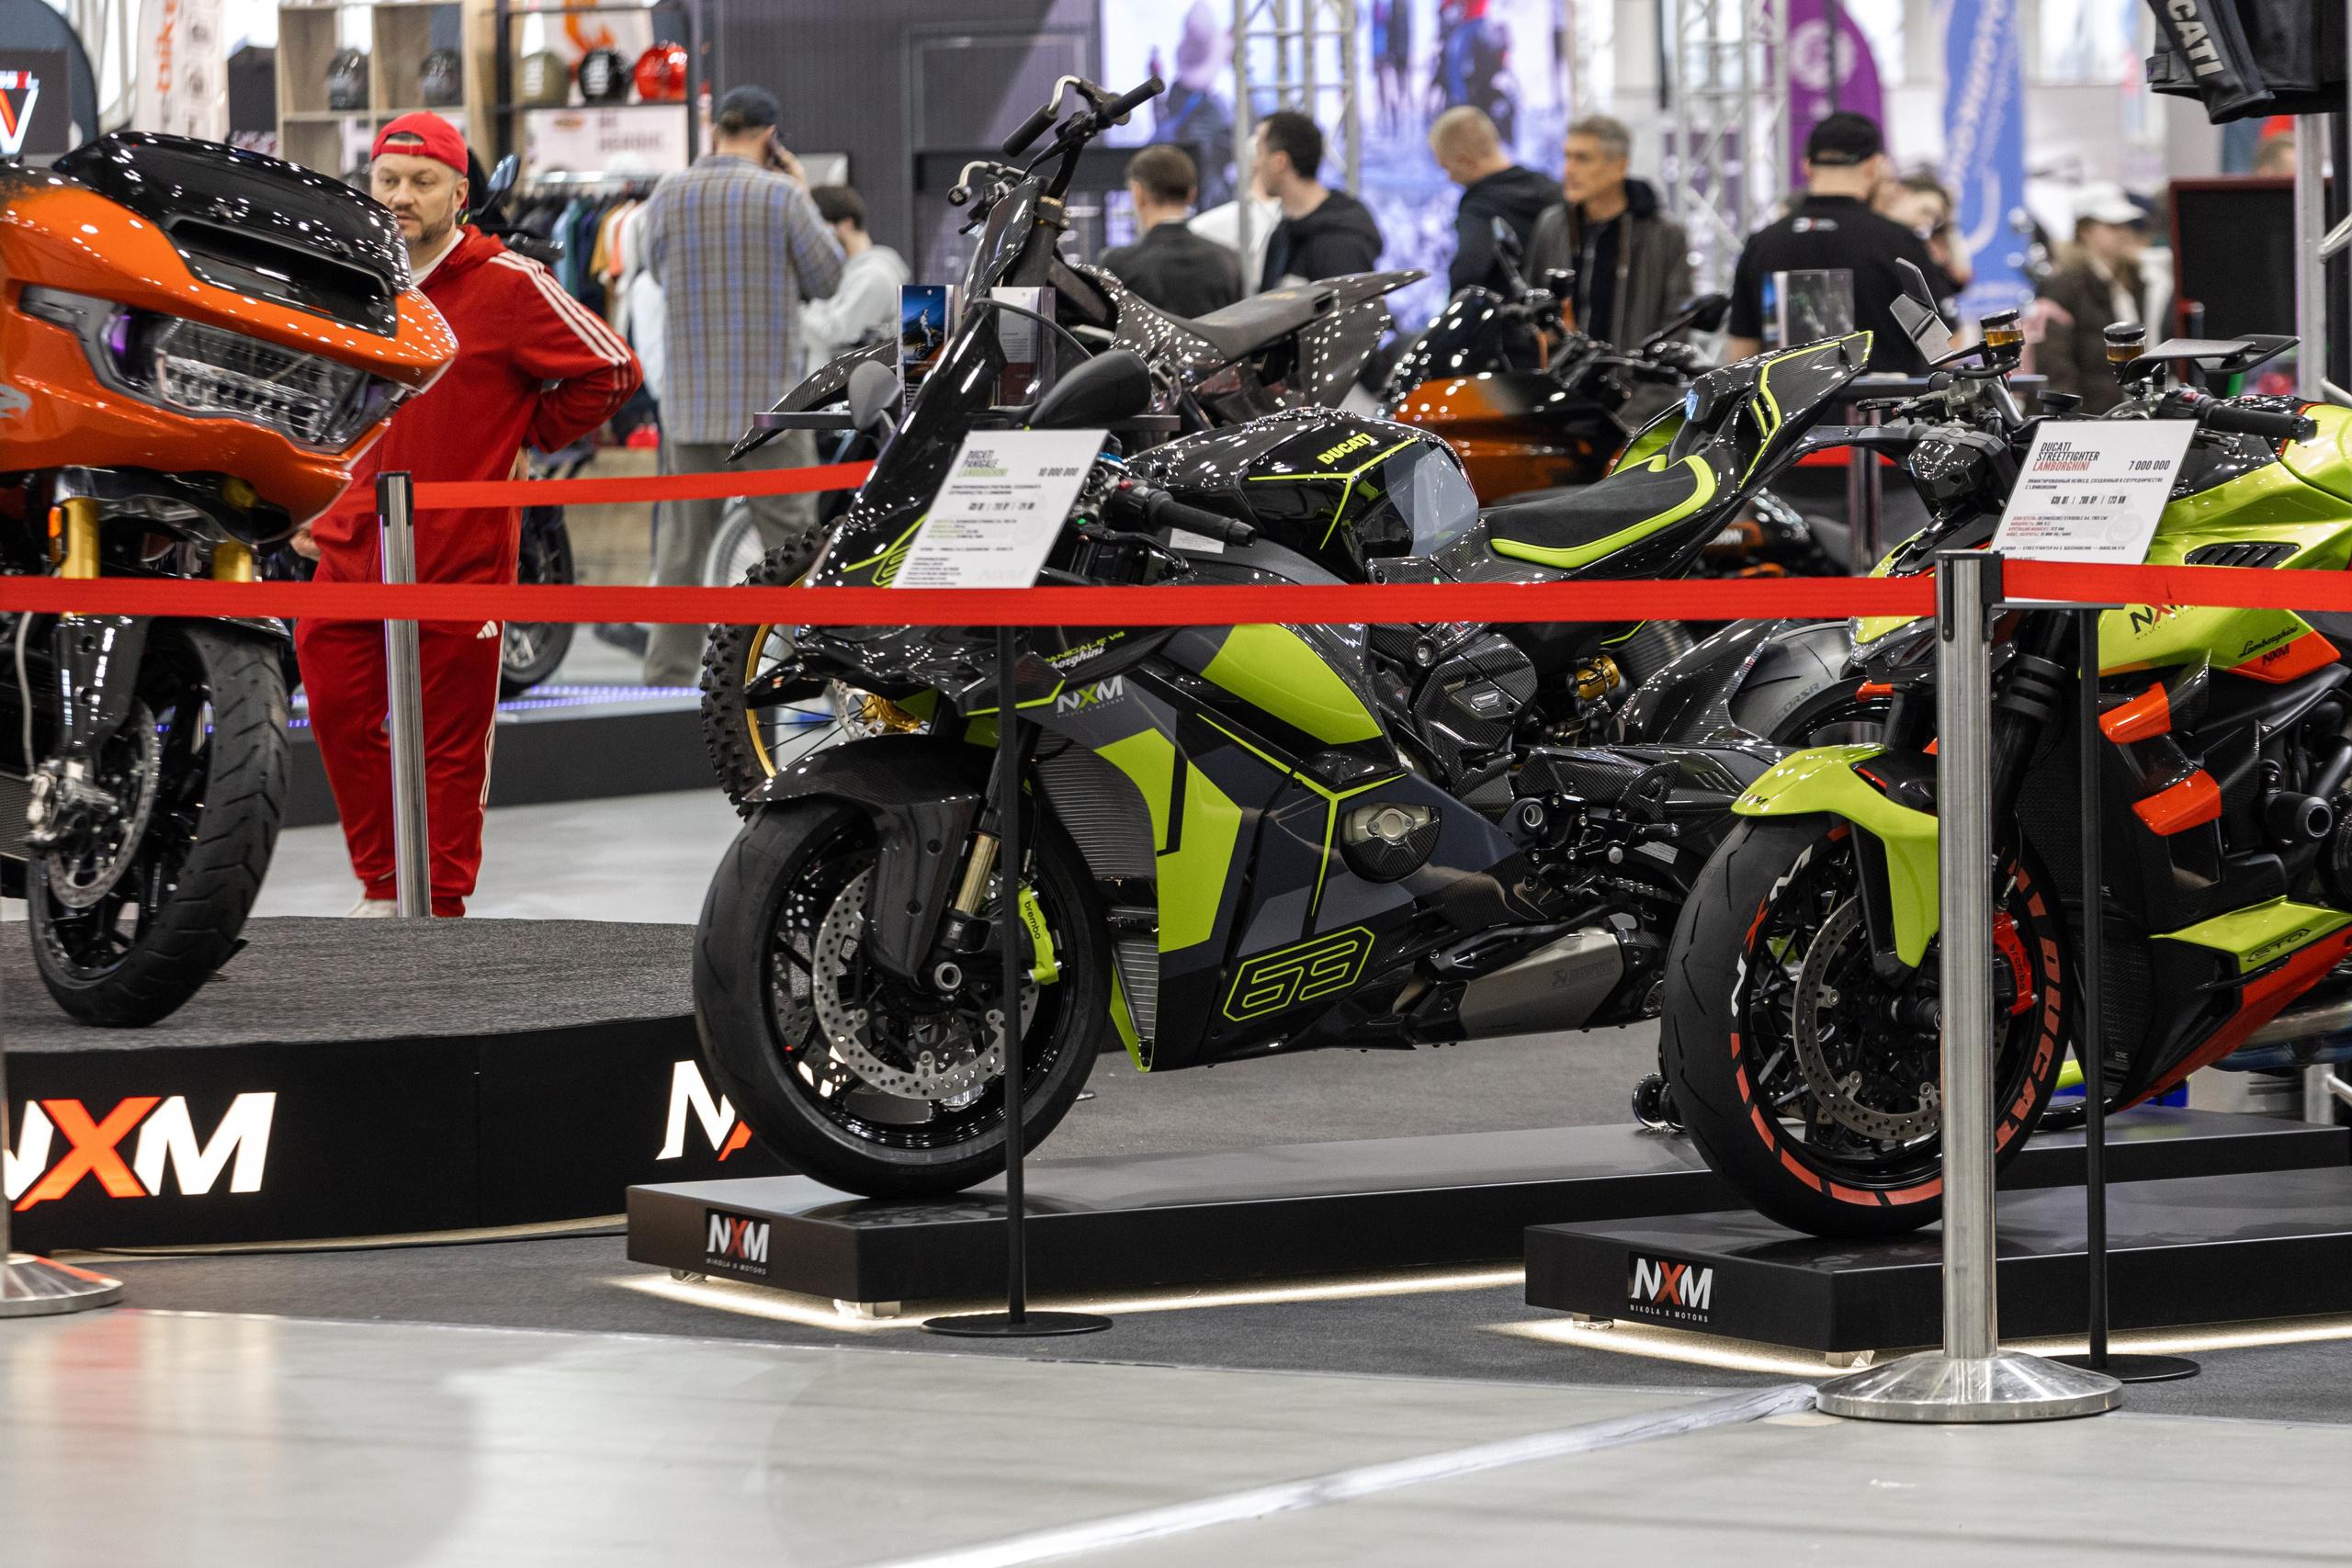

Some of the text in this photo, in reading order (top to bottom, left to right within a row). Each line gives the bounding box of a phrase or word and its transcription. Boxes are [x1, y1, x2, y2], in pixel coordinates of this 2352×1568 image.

[2165, 0, 2224, 77] CATI
[1317, 433, 1376, 465] DUCATI
[2036, 451, 2100, 461] STREETFIGHTER
[2040, 442, 2073, 452] DUCATI
[2128, 460, 2171, 470] 7 000 000
[2032, 461, 2091, 471] LAMBORGHINI
[1051, 643, 1105, 669] borghini
[2238, 623, 2299, 659] Lamborghini
[1057, 674, 1124, 714] NXM
[1024, 900, 1041, 940] brembo
[2009, 942, 2027, 990] brembo
[1996, 937, 2062, 1154] DUCAT
[707, 1214, 770, 1263] NXM
[1631, 1258, 1713, 1310] NXM
[1630, 1304, 1709, 1323] NIKOLA X MOTORS
